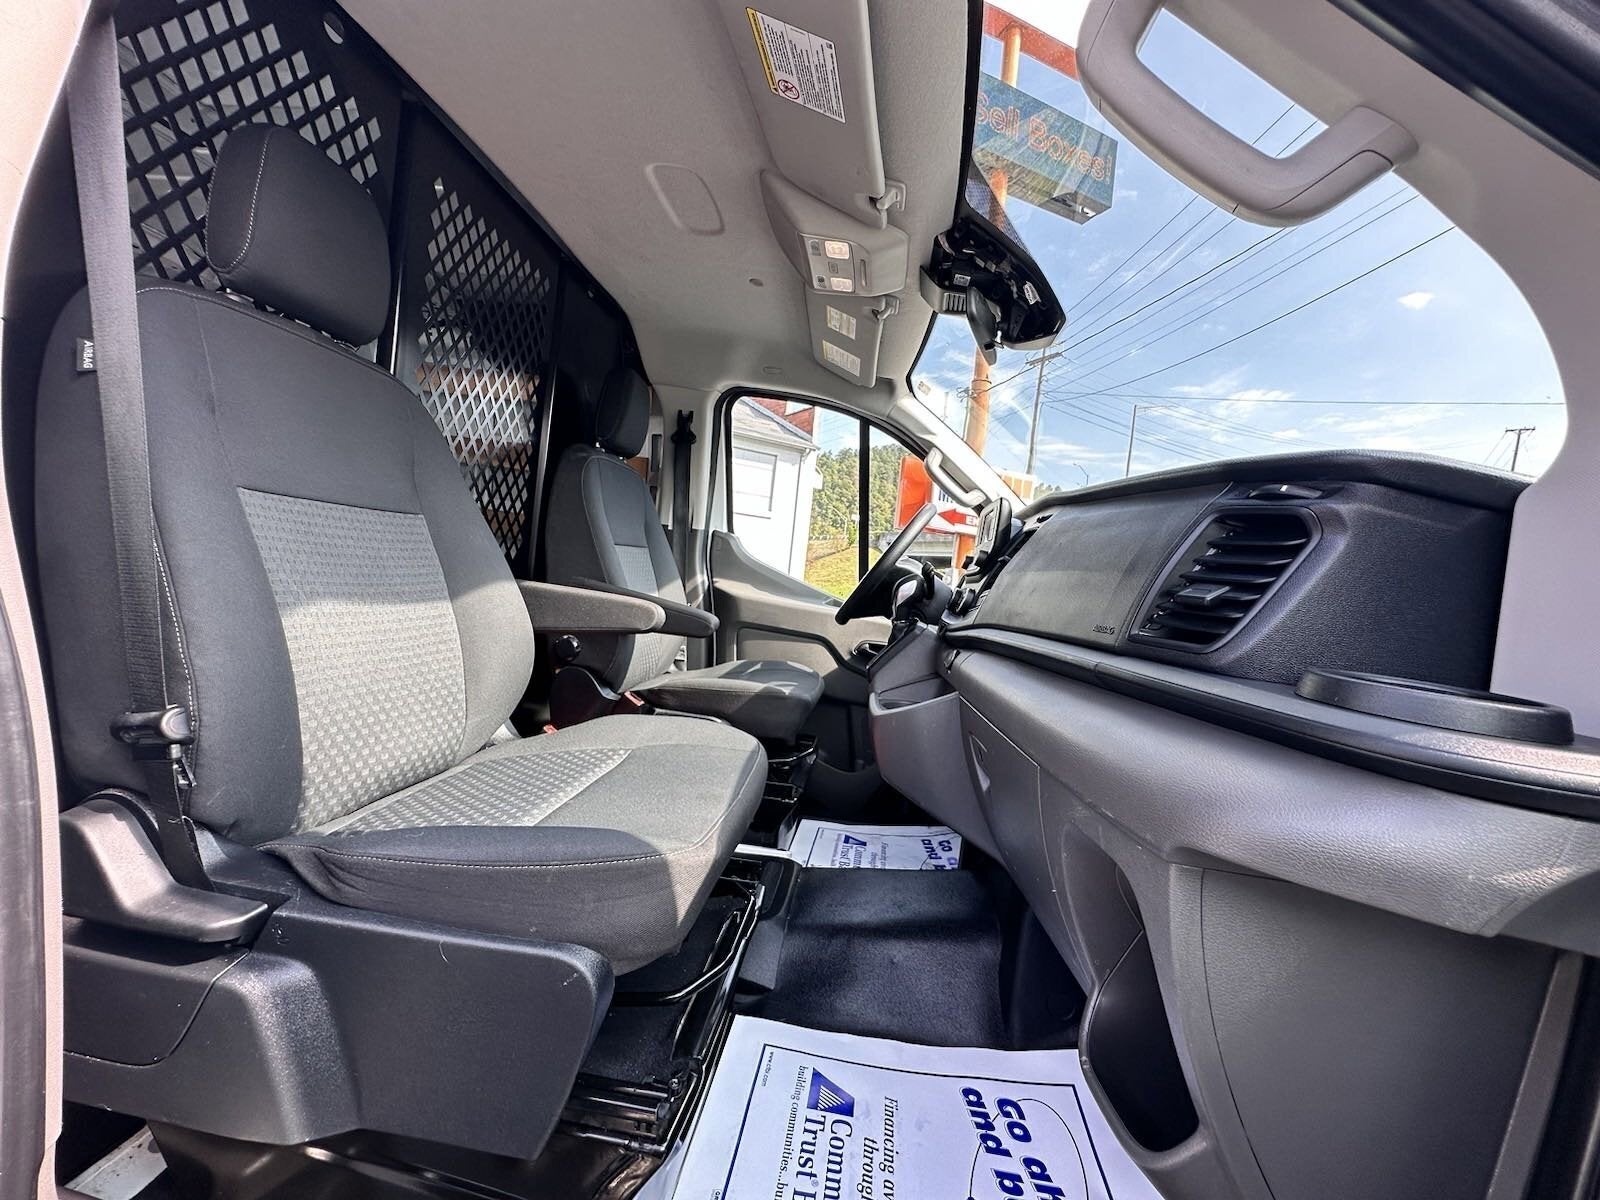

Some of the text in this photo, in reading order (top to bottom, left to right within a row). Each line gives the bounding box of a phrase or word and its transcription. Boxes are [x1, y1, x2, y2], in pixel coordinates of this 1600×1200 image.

[83, 340, 94, 369] AIRBAG
[791, 1065, 808, 1100] building
[879, 1096, 899, 1175] Financing
[959, 1086, 1025, 1200] and b
[994, 1097, 1032, 1143] Go
[823, 1119, 853, 1200] Comm
